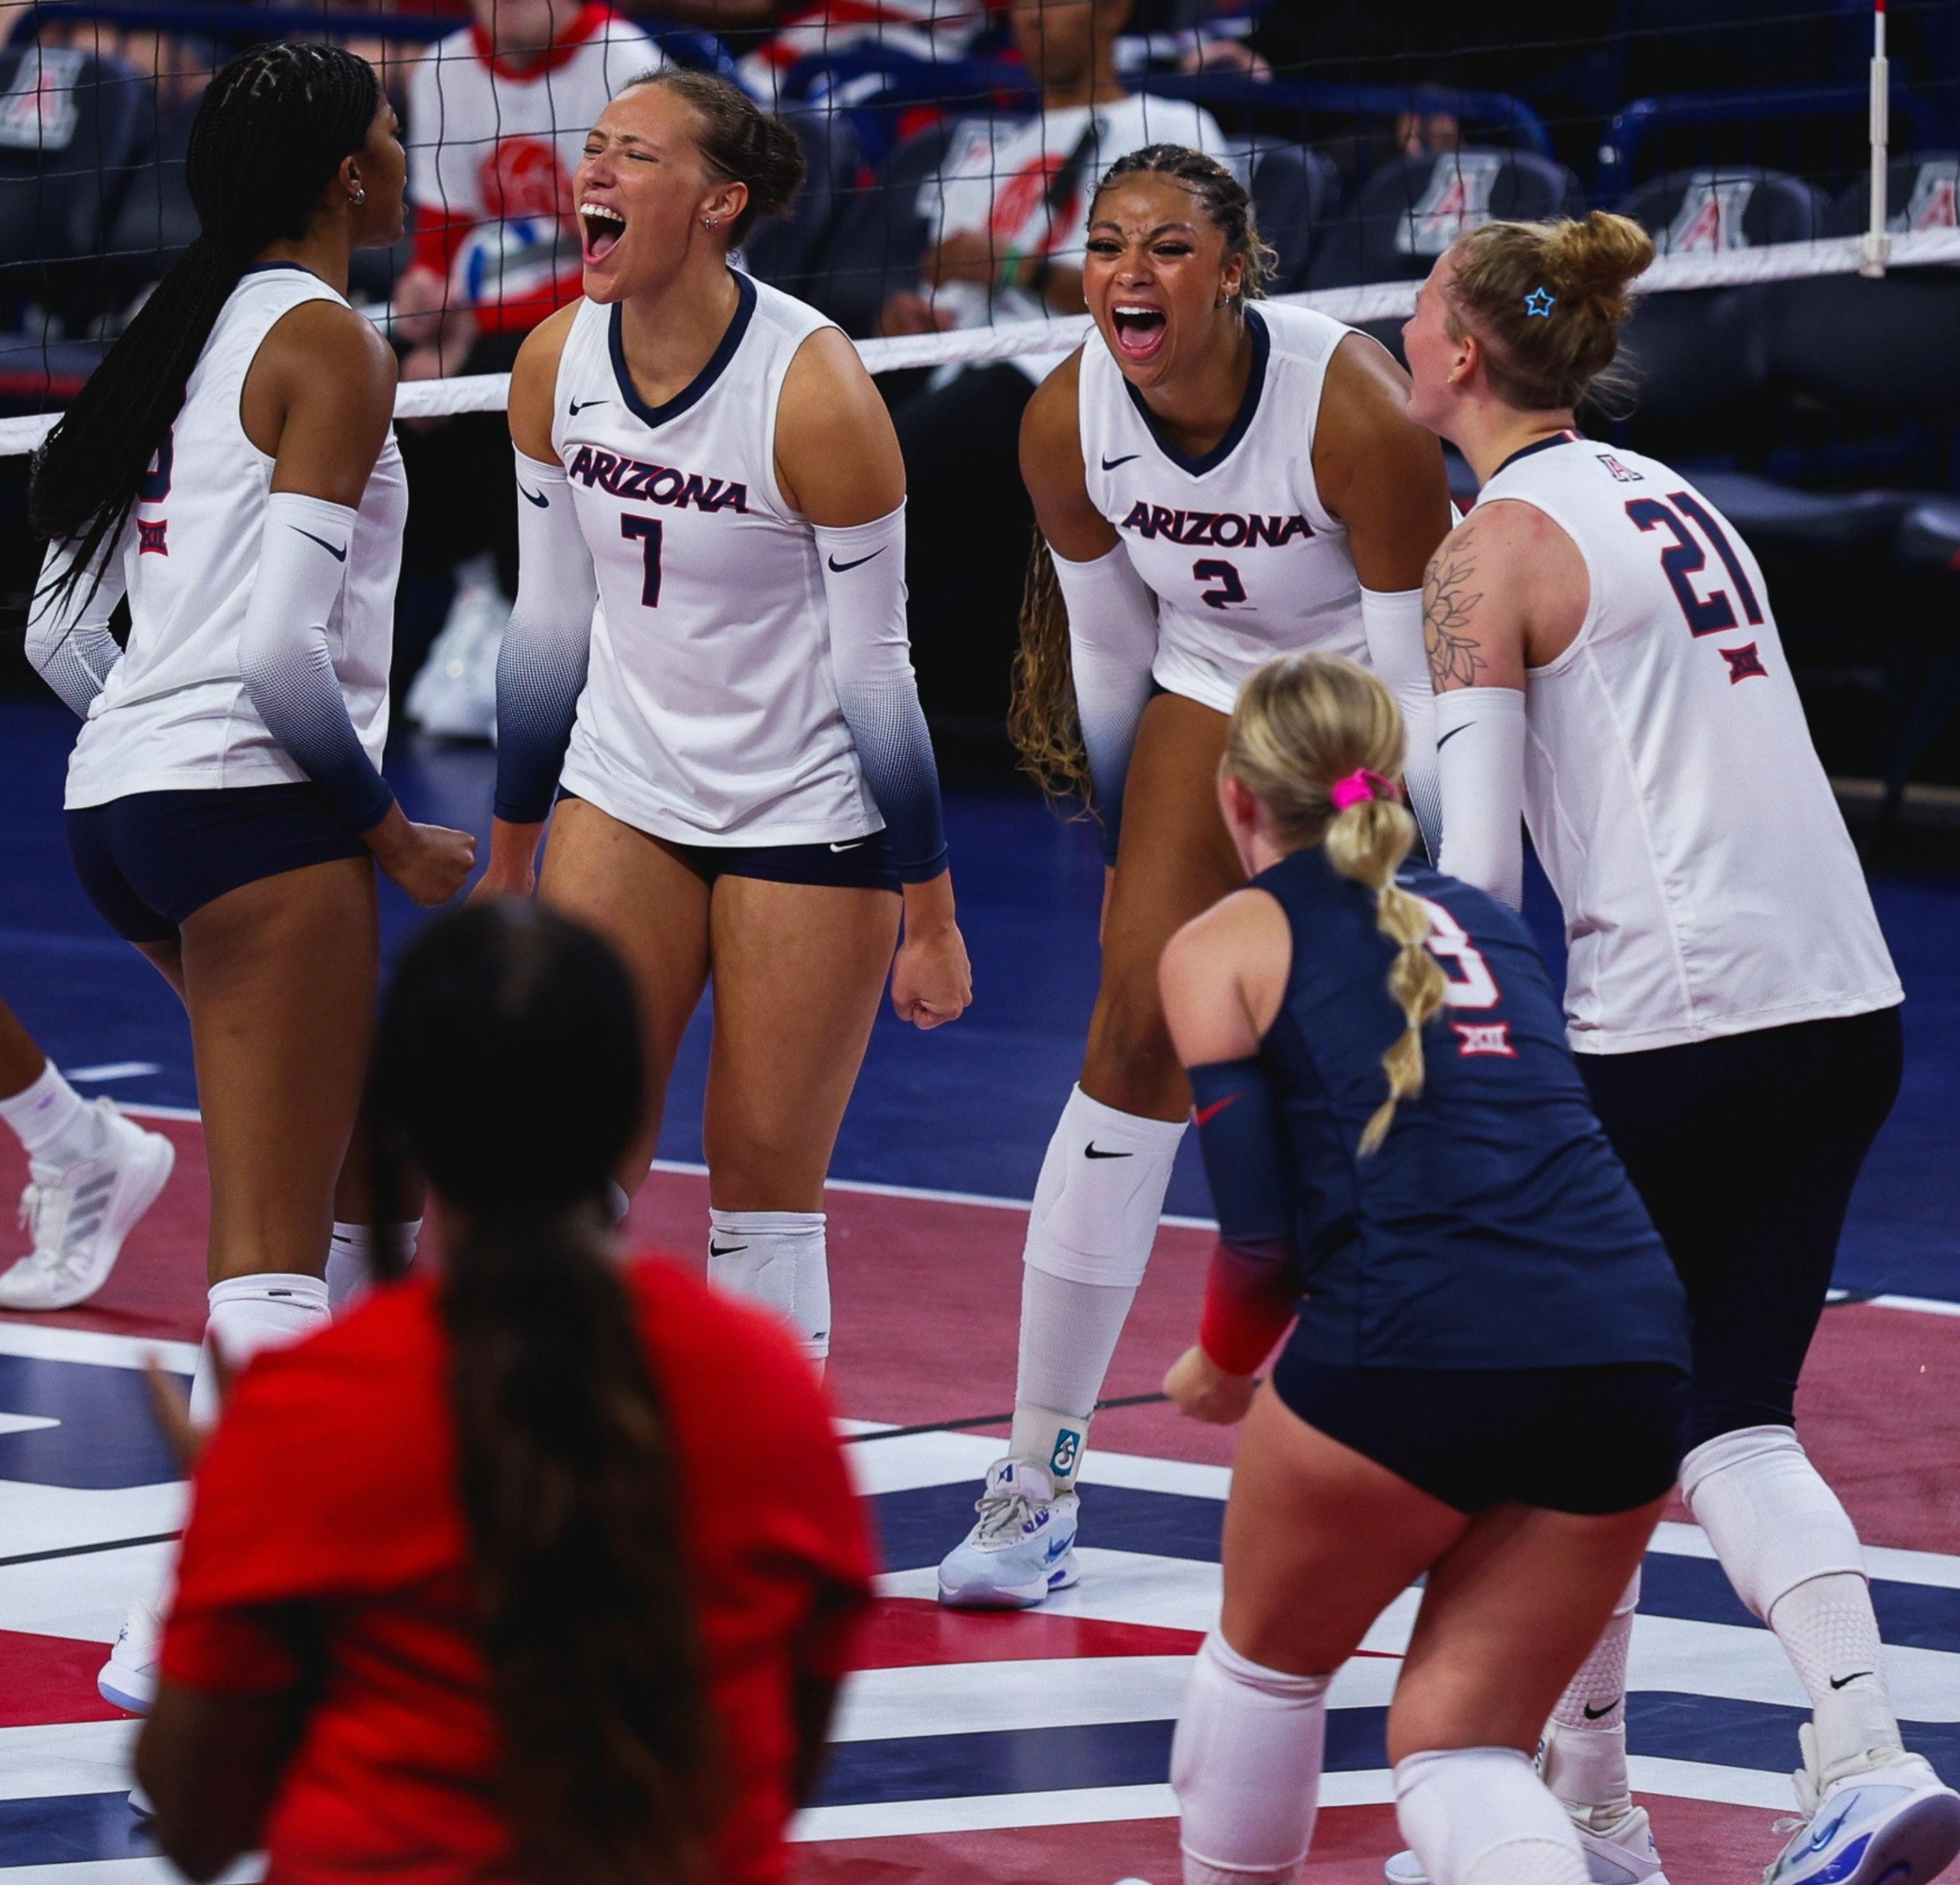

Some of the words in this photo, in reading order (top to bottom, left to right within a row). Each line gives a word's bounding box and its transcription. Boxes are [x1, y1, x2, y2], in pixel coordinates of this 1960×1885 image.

[569, 444, 750, 514] ARIZONA
[1120, 500, 1316, 548] ARIZONA
[620, 512, 663, 609] 7
[1192, 558, 1247, 610] 2
[1624, 491, 1765, 639] 21
